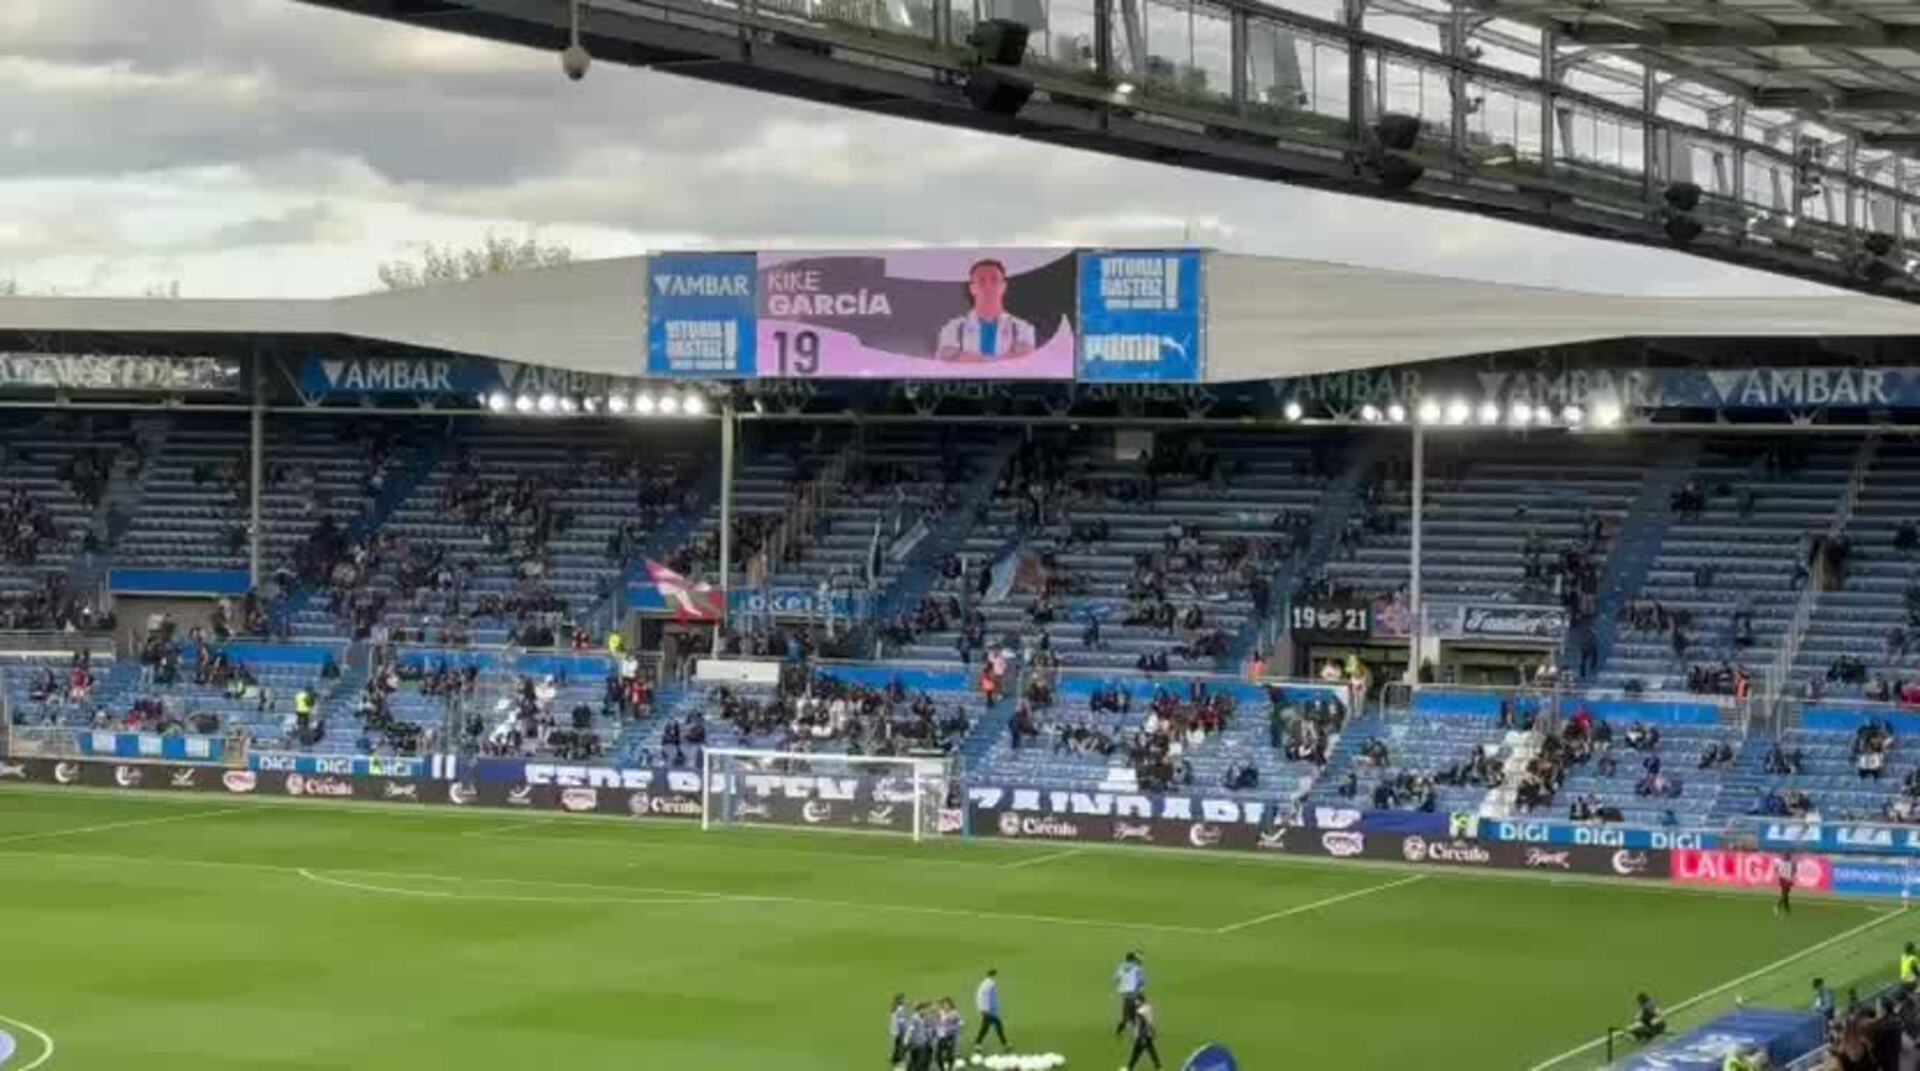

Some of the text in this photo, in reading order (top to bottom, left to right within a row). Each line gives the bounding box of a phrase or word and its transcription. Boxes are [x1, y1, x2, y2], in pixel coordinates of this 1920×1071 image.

[670, 275, 749, 296] AMBAR
[768, 270, 822, 292] KIKE
[768, 288, 892, 315] GARCÍA
[774, 331, 820, 375] 19
[344, 360, 452, 389] AMBAR
[1293, 369, 1422, 402] AMBAR
[1741, 368, 1888, 404] AMBAR
[1293, 608, 1368, 631] 19 21
[1501, 823, 1700, 850] DIGI DIGI DIGI
